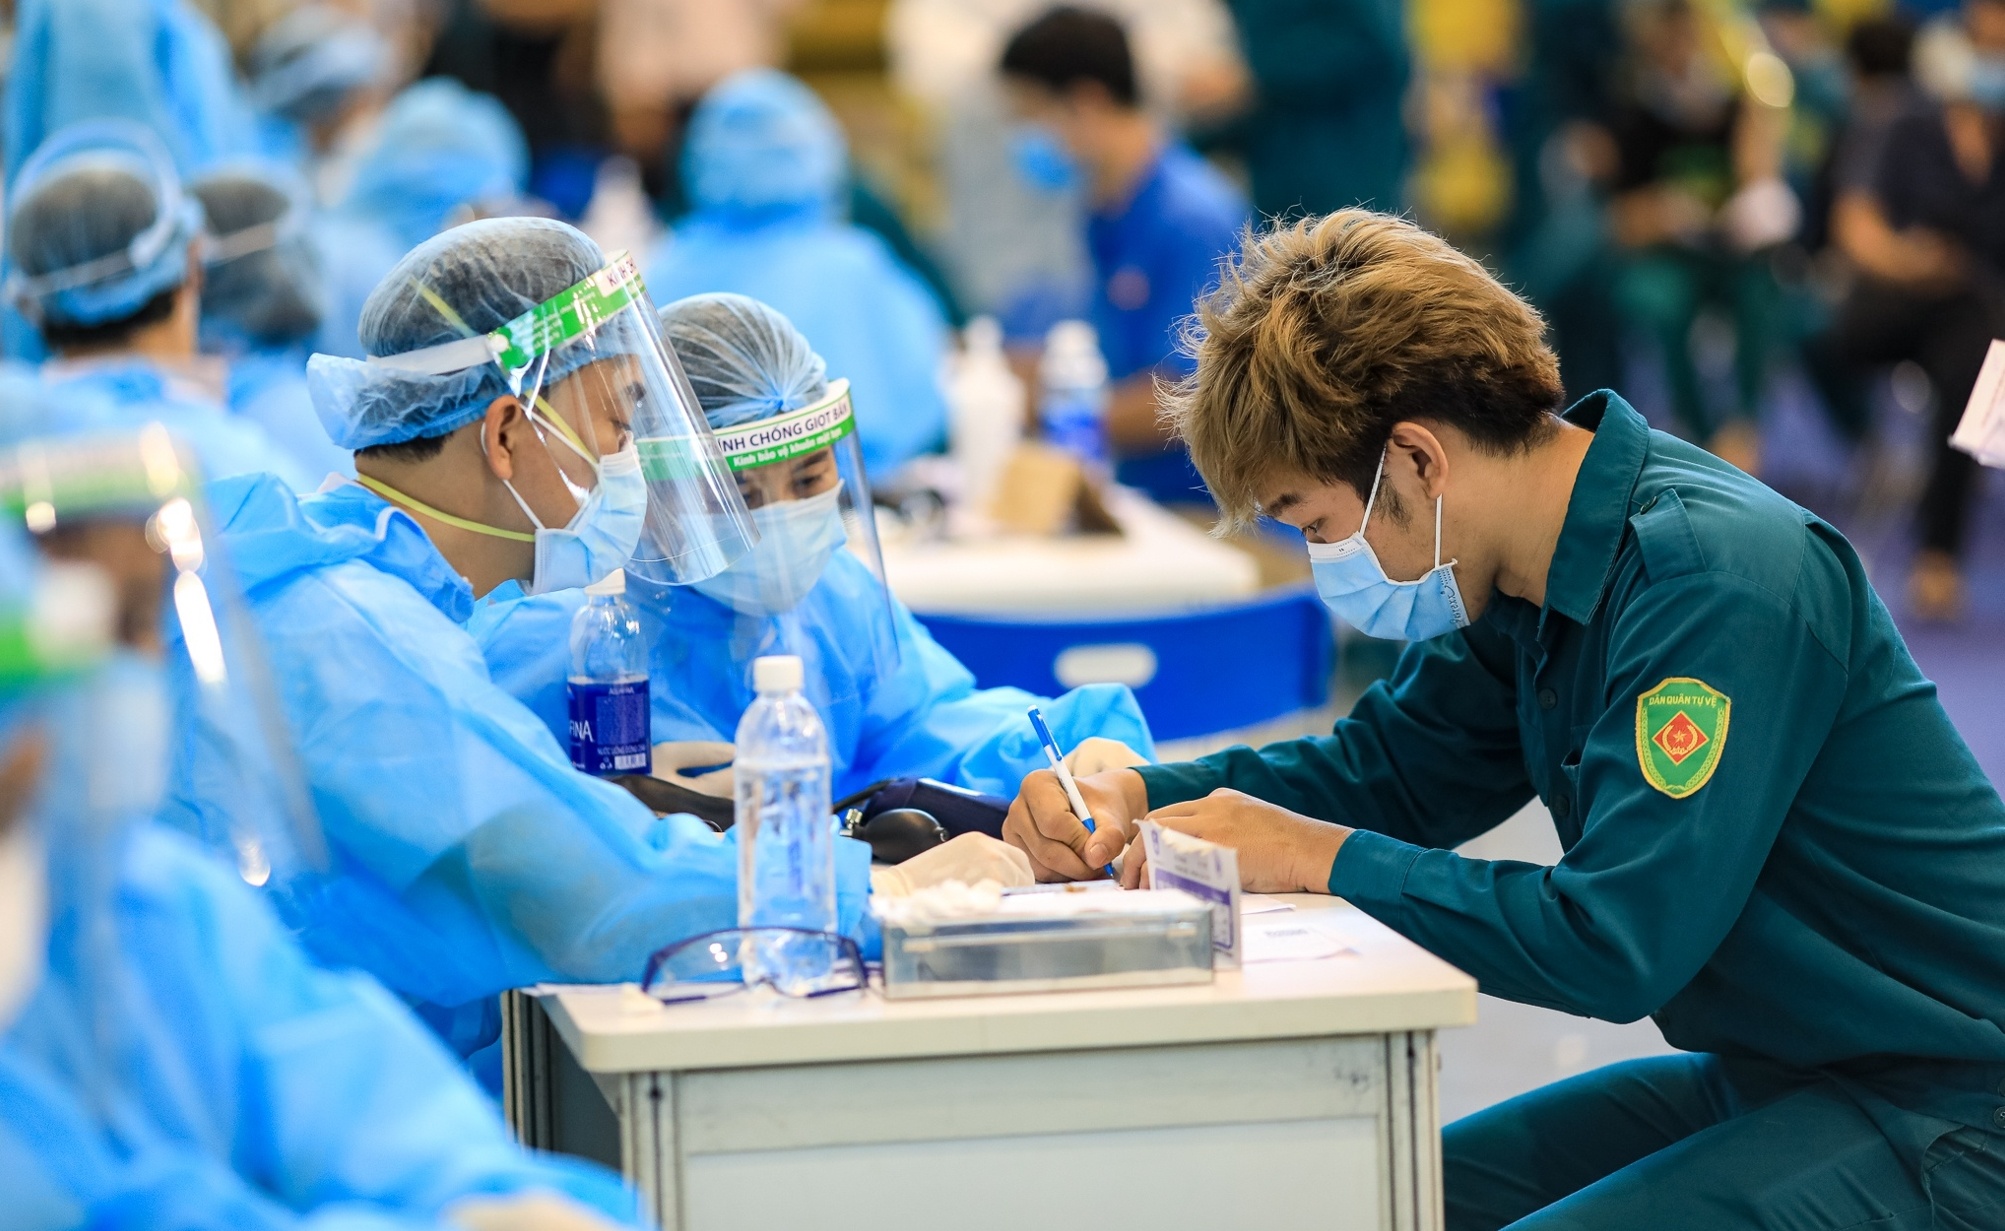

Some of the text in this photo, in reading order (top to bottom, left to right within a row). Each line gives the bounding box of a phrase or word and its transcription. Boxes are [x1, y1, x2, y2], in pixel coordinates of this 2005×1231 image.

[710, 437, 746, 453] ÍNH
[749, 422, 803, 447] CHỐNG
[1649, 693, 1666, 706] DÂN
[1666, 692, 1691, 705] QUÂN
[1705, 695, 1717, 708] VỆ
